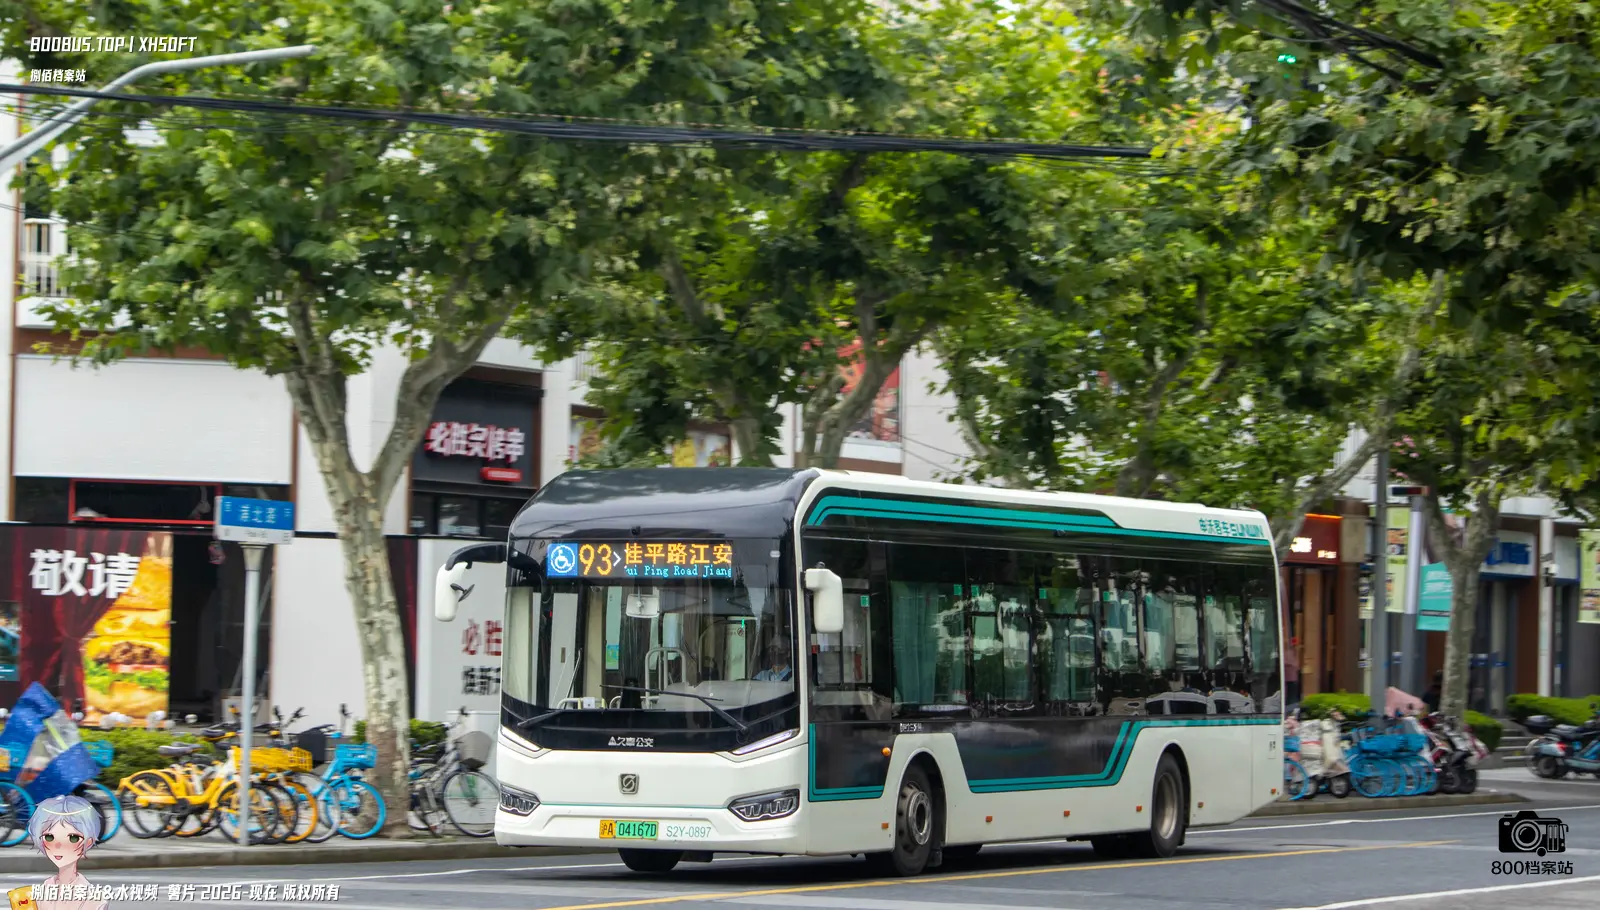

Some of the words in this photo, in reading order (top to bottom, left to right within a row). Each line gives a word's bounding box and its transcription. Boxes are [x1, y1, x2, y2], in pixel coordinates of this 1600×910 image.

[579, 543, 613, 576] 93
[624, 542, 733, 565] 桂平路江安
[29, 548, 141, 599] 敬请
[625, 564, 638, 577] ui
[644, 564, 669, 578] Ping
[673, 563, 698, 576] Road
[618, 822, 657, 838] 04167D
[666, 825, 712, 839] S2Y-0897
